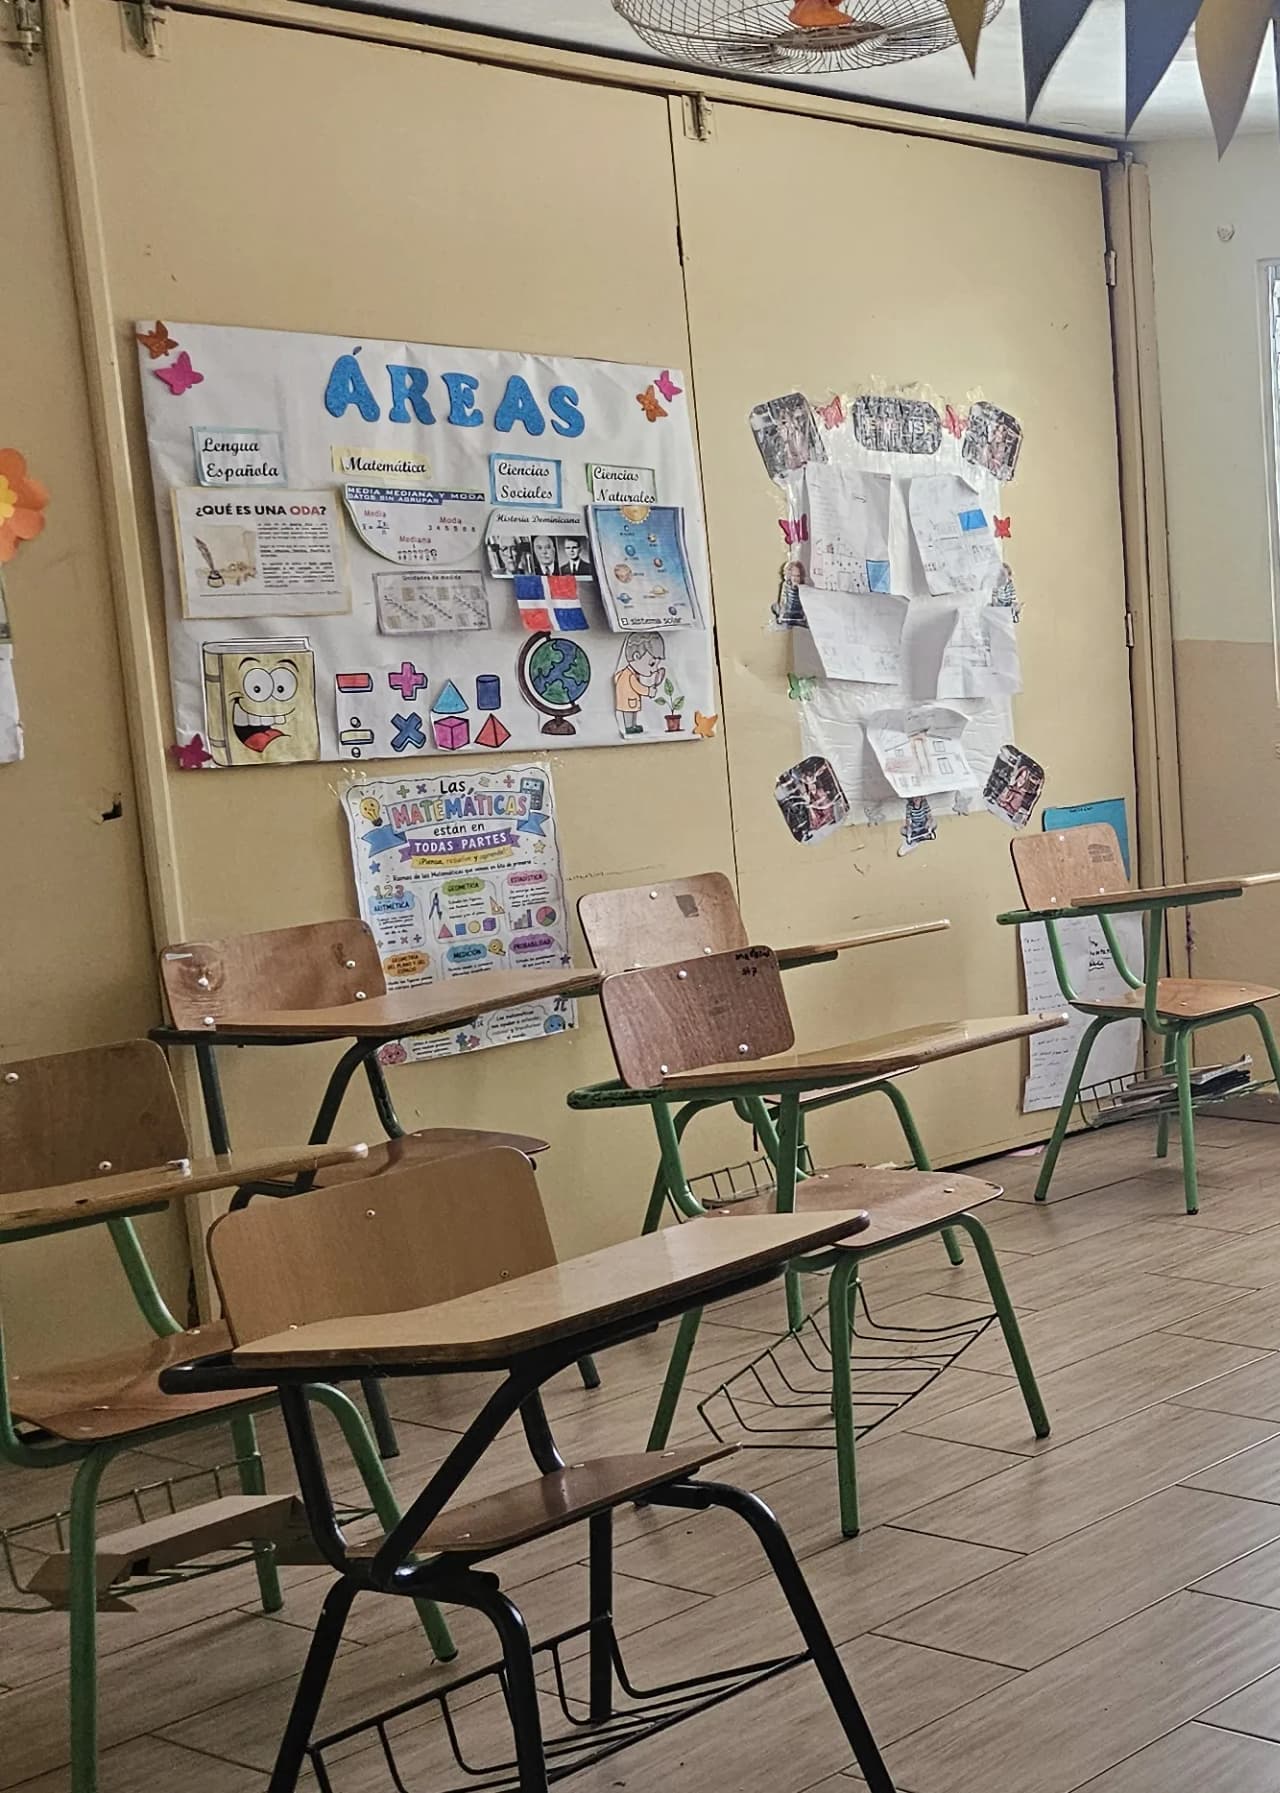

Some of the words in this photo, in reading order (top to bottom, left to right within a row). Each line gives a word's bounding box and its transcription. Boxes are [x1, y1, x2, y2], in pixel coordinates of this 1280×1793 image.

[323, 346, 586, 438] ÁREAS
[202, 437, 259, 456] Lengua
[206, 462, 279, 482] Española
[345, 456, 427, 473] Matemática
[498, 462, 550, 477] Ciencias
[593, 467, 639, 481] Ciencias
[347, 486, 381, 495] MEDIA
[388, 489, 433, 498] MEDIANA
[450, 492, 484, 500] MODA
[500, 485, 553, 499] Sociales
[596, 489, 656, 504] Naturales
[195, 503, 233, 517] ¿QUÉ
[236, 505, 251, 515] ES
[254, 504, 287, 516] UNA
[289, 505, 326, 516] ODA?
[439, 516, 463, 524] Moda
[495, 513, 529, 524] Historia
[531, 514, 581, 525] Dominicana
[440, 780, 466, 794] Las
[391, 788, 528, 829] MATEMÁTICAS
[433, 825, 467, 837] están
[471, 822, 485, 832] en
[414, 840, 454, 853] TODAS
[461, 832, 507, 850] PARTES
